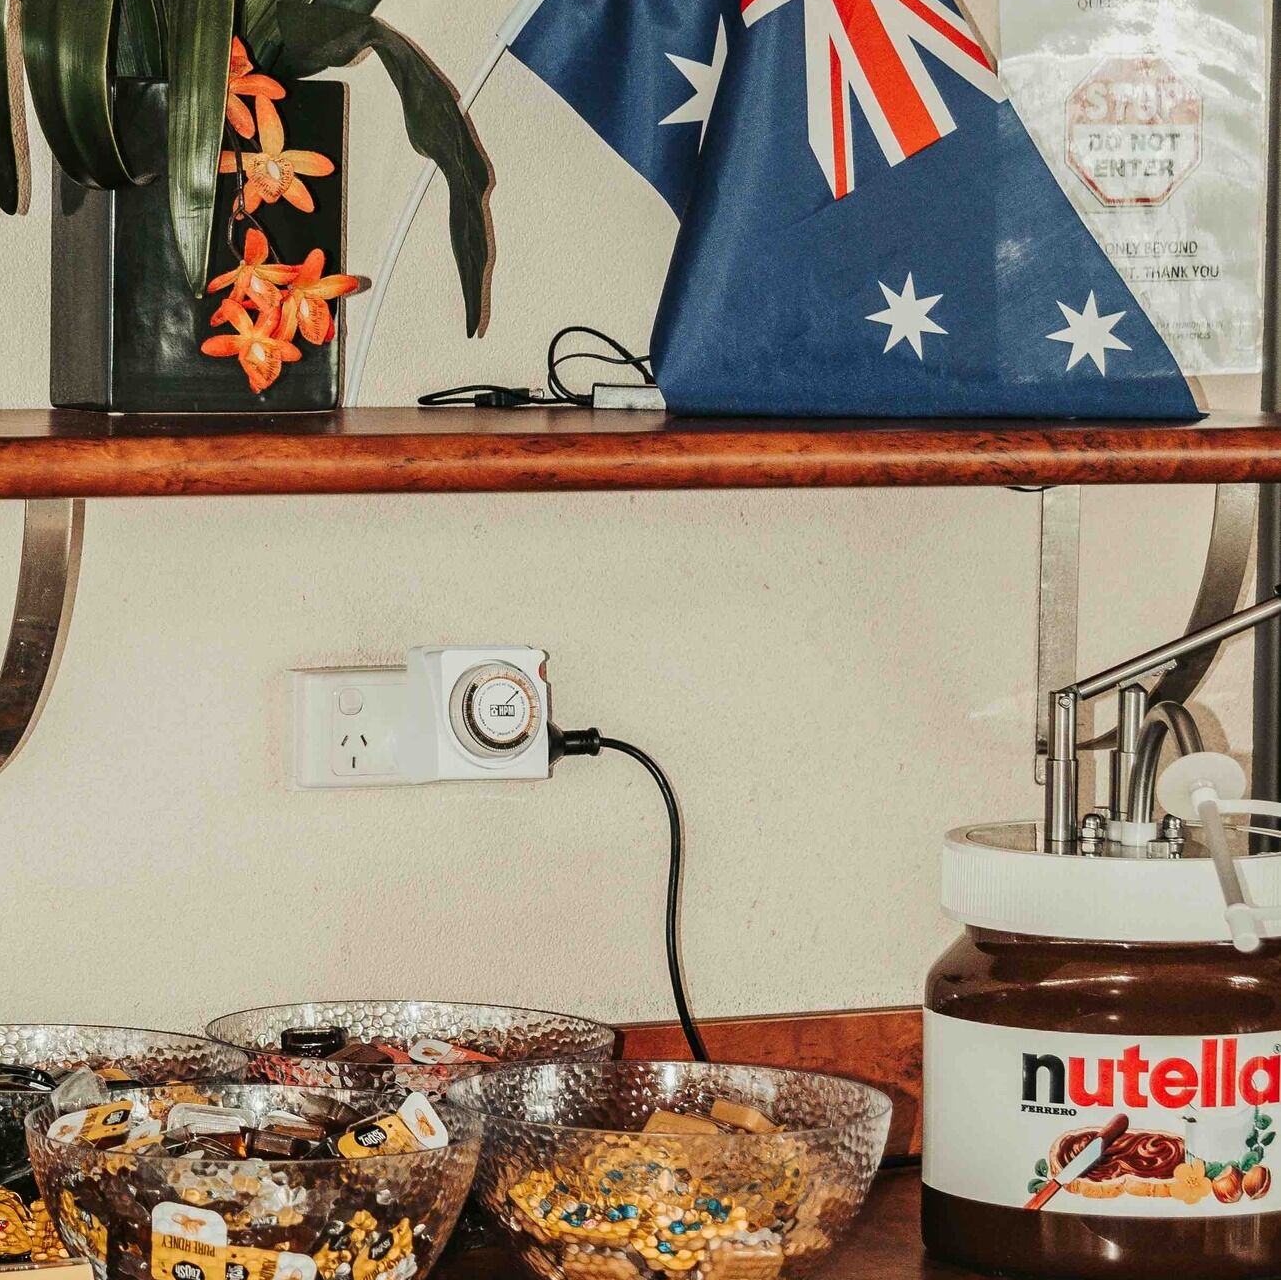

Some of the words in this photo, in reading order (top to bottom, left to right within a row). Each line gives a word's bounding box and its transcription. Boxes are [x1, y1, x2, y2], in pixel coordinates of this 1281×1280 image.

[1089, 133, 1121, 152] DO
[1130, 133, 1180, 152] NOT
[1094, 159, 1175, 178] ENTER
[1144, 240, 1199, 255] BEYOND
[1143, 266, 1189, 279] THANK
[1192, 265, 1220, 278] YOU
[499, 705, 515, 716] HPM
[1022, 1038, 1281, 1109] nutella
[1021, 1104, 1077, 1117] FERRERO
